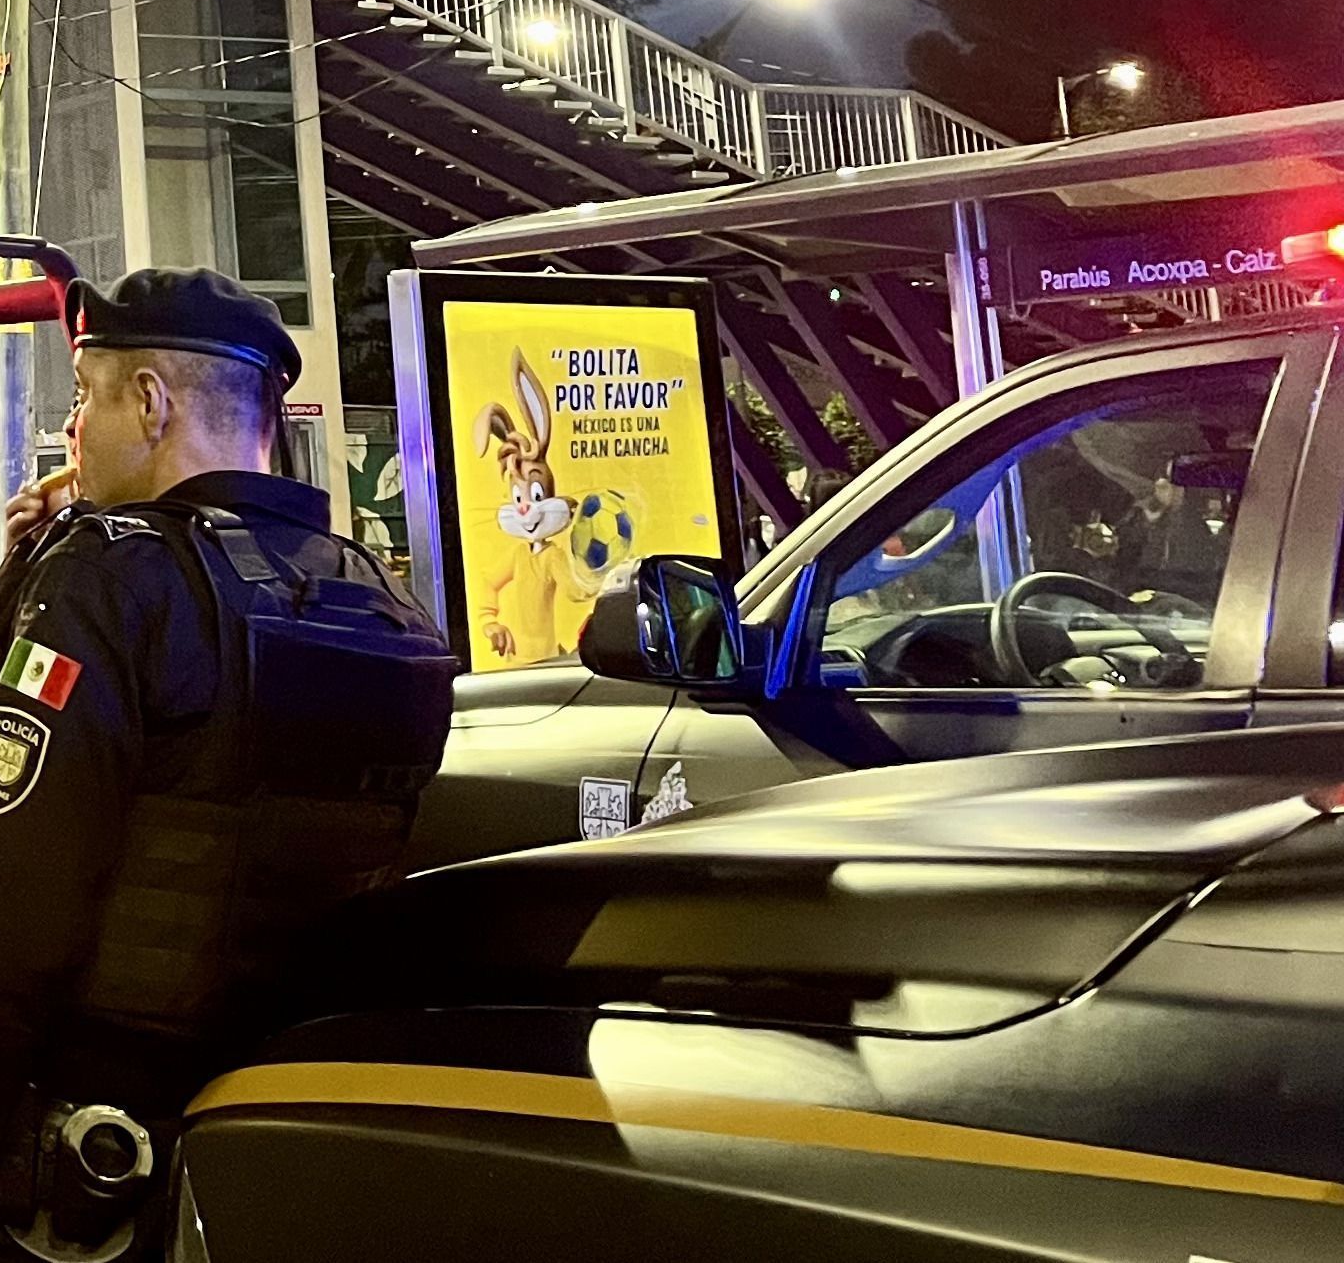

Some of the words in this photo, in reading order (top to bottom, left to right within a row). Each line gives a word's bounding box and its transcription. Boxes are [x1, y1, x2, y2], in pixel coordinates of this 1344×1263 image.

[1040, 265, 1110, 290] Parabús
[1127, 257, 1210, 284] Acoxpa
[555, 383, 596, 412] POR
[572, 415, 616, 434] MÉXICO
[620, 417, 633, 433] ES
[637, 416, 660, 432] UNA
[570, 439, 609, 459] GRAN
[614, 436, 669, 457] CANCHA
